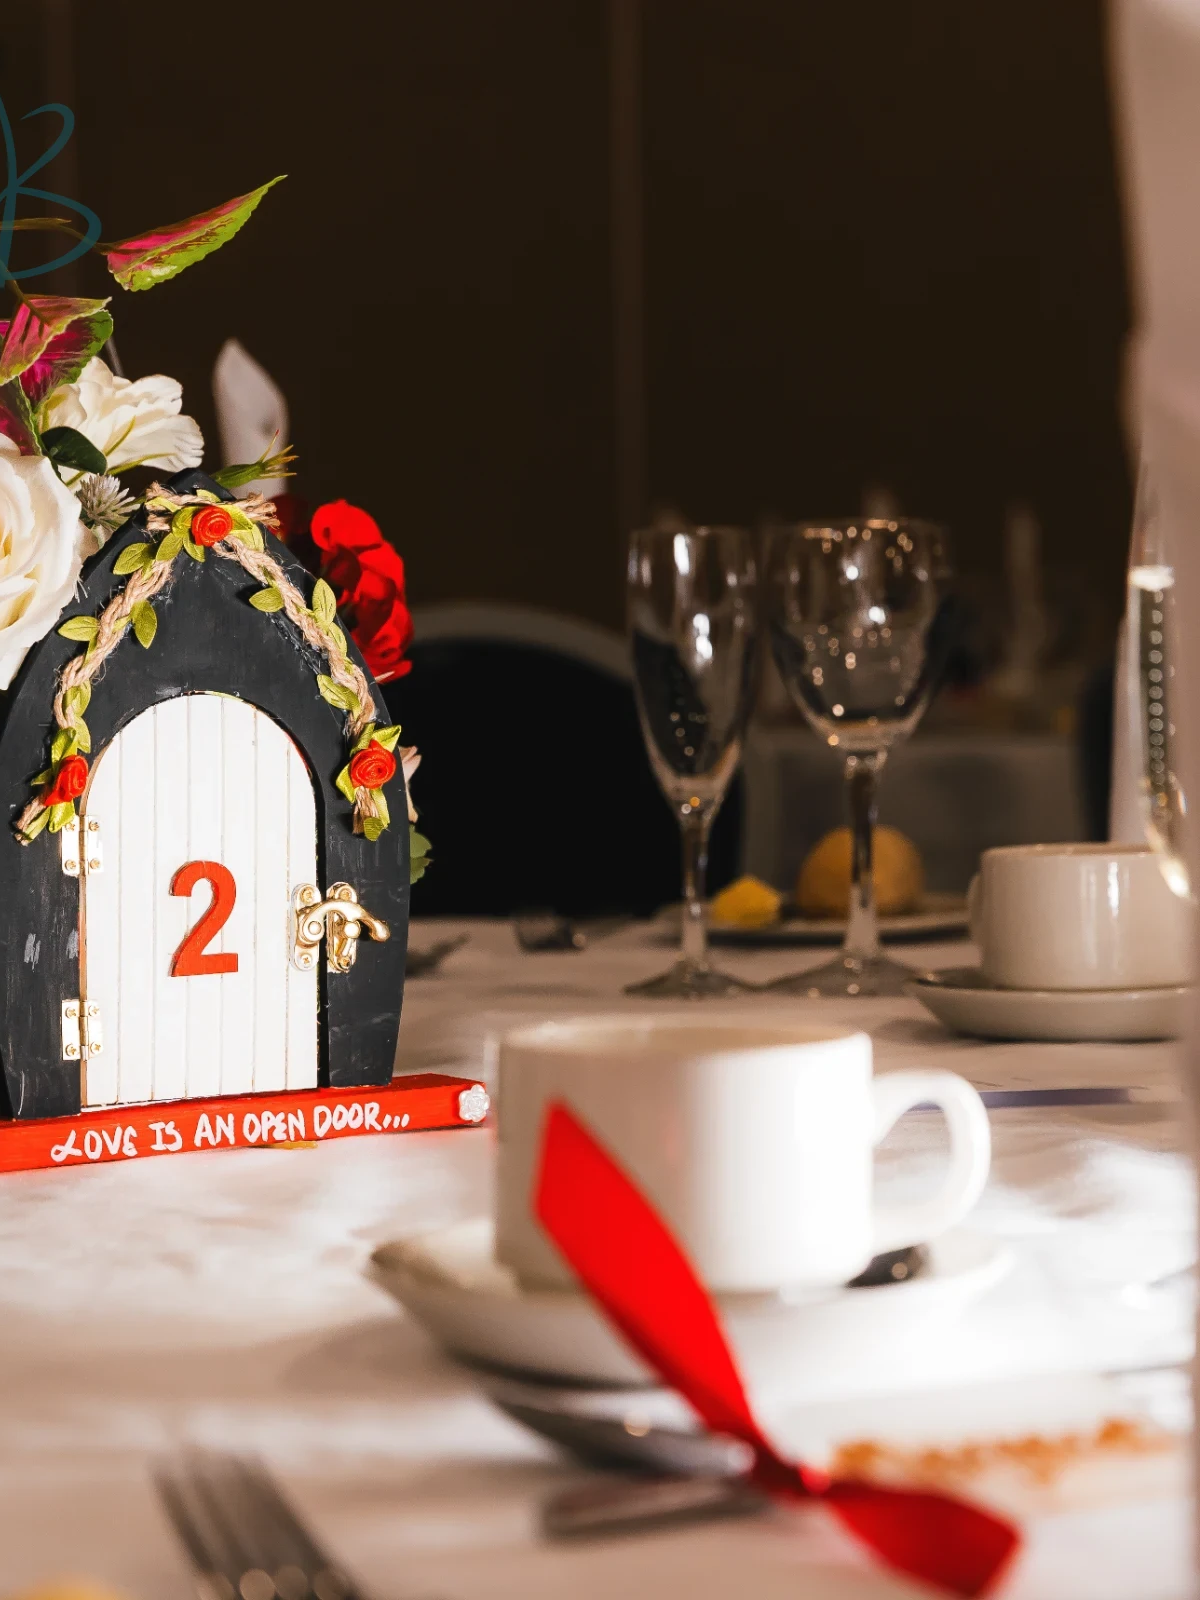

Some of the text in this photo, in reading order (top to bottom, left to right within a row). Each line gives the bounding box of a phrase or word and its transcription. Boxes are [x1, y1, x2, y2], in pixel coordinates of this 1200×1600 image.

[168, 860, 239, 977] 2
[50, 1125, 138, 1162] LOVE
[148, 1120, 183, 1151] IS
[194, 1113, 235, 1147] AN
[242, 1109, 306, 1143] OPEN
